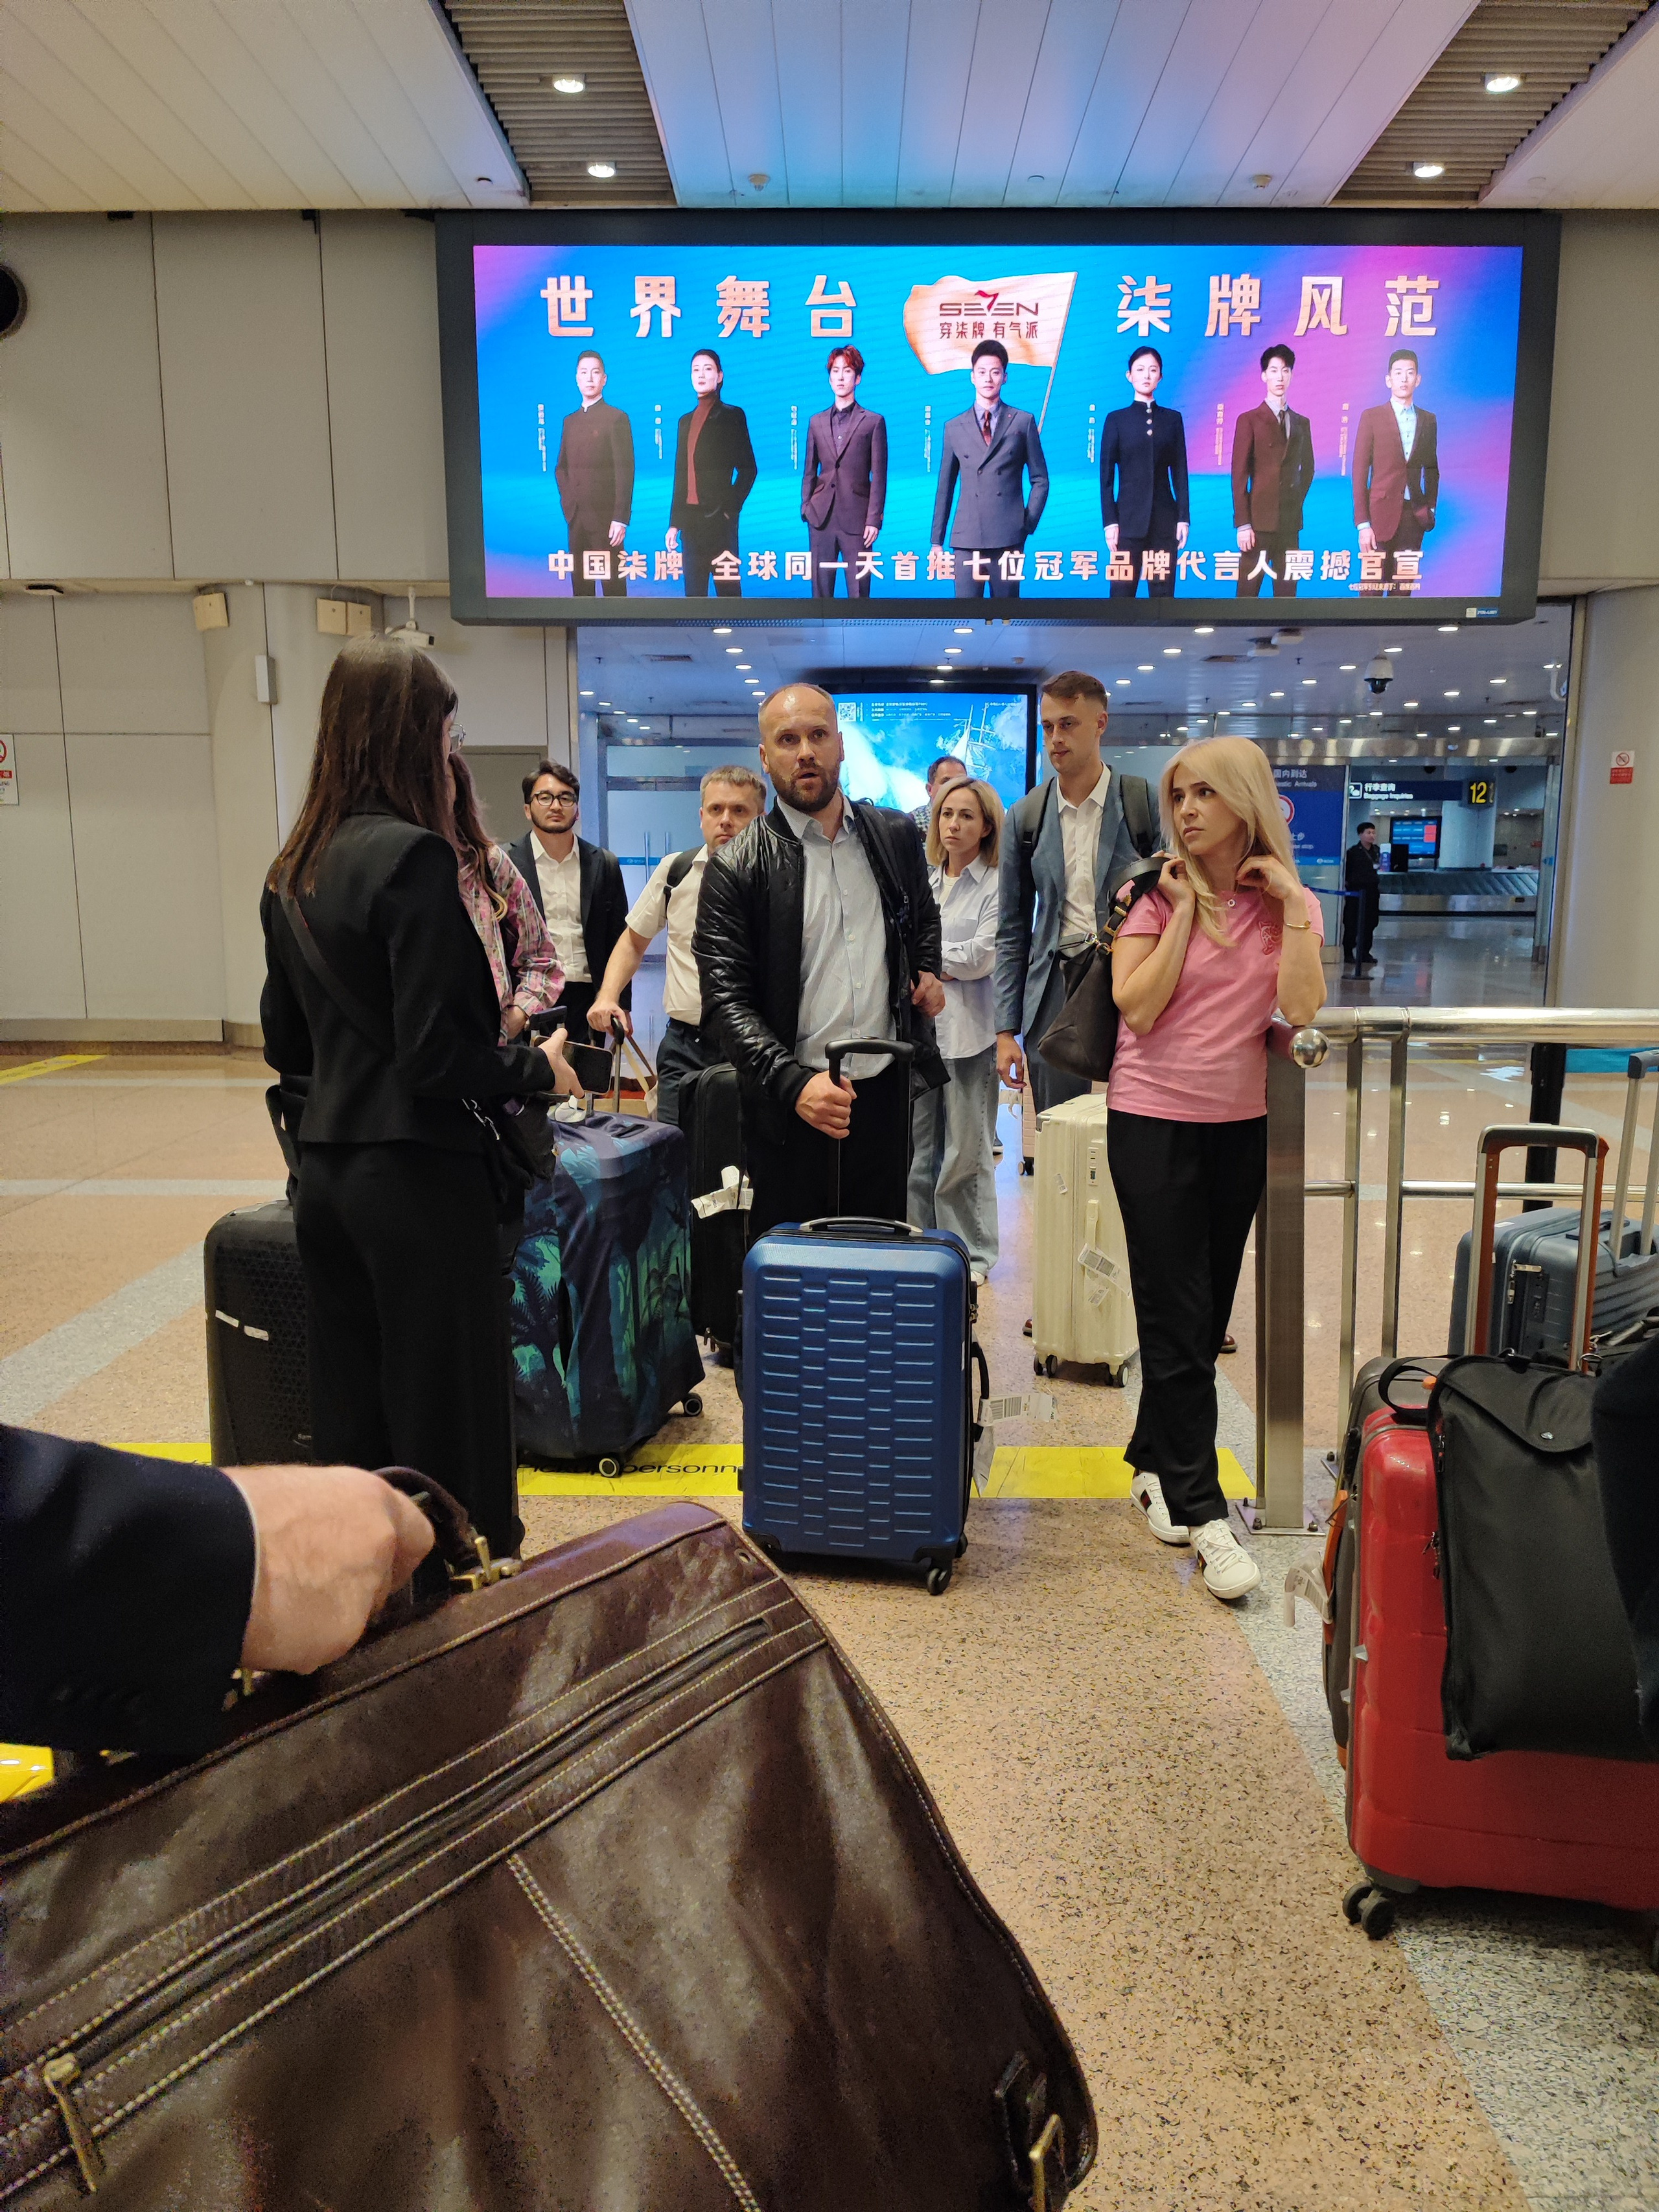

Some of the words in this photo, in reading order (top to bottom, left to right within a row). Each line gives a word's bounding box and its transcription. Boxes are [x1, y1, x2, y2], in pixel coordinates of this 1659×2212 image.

[539, 275, 857, 338] 世界舞台
[1116, 274, 1440, 337] 柒牌风范
[940, 291, 1039, 316] SEVEN
[940, 321, 985, 340] 穿柒牌
[993, 321, 1038, 340] 有气派
[548, 550, 684, 581] 中国柒牌
[711, 550, 1424, 581] 全球同一天首推七位冠军品牌代言人震撼官宣
[1470, 782, 1487, 804] 12
